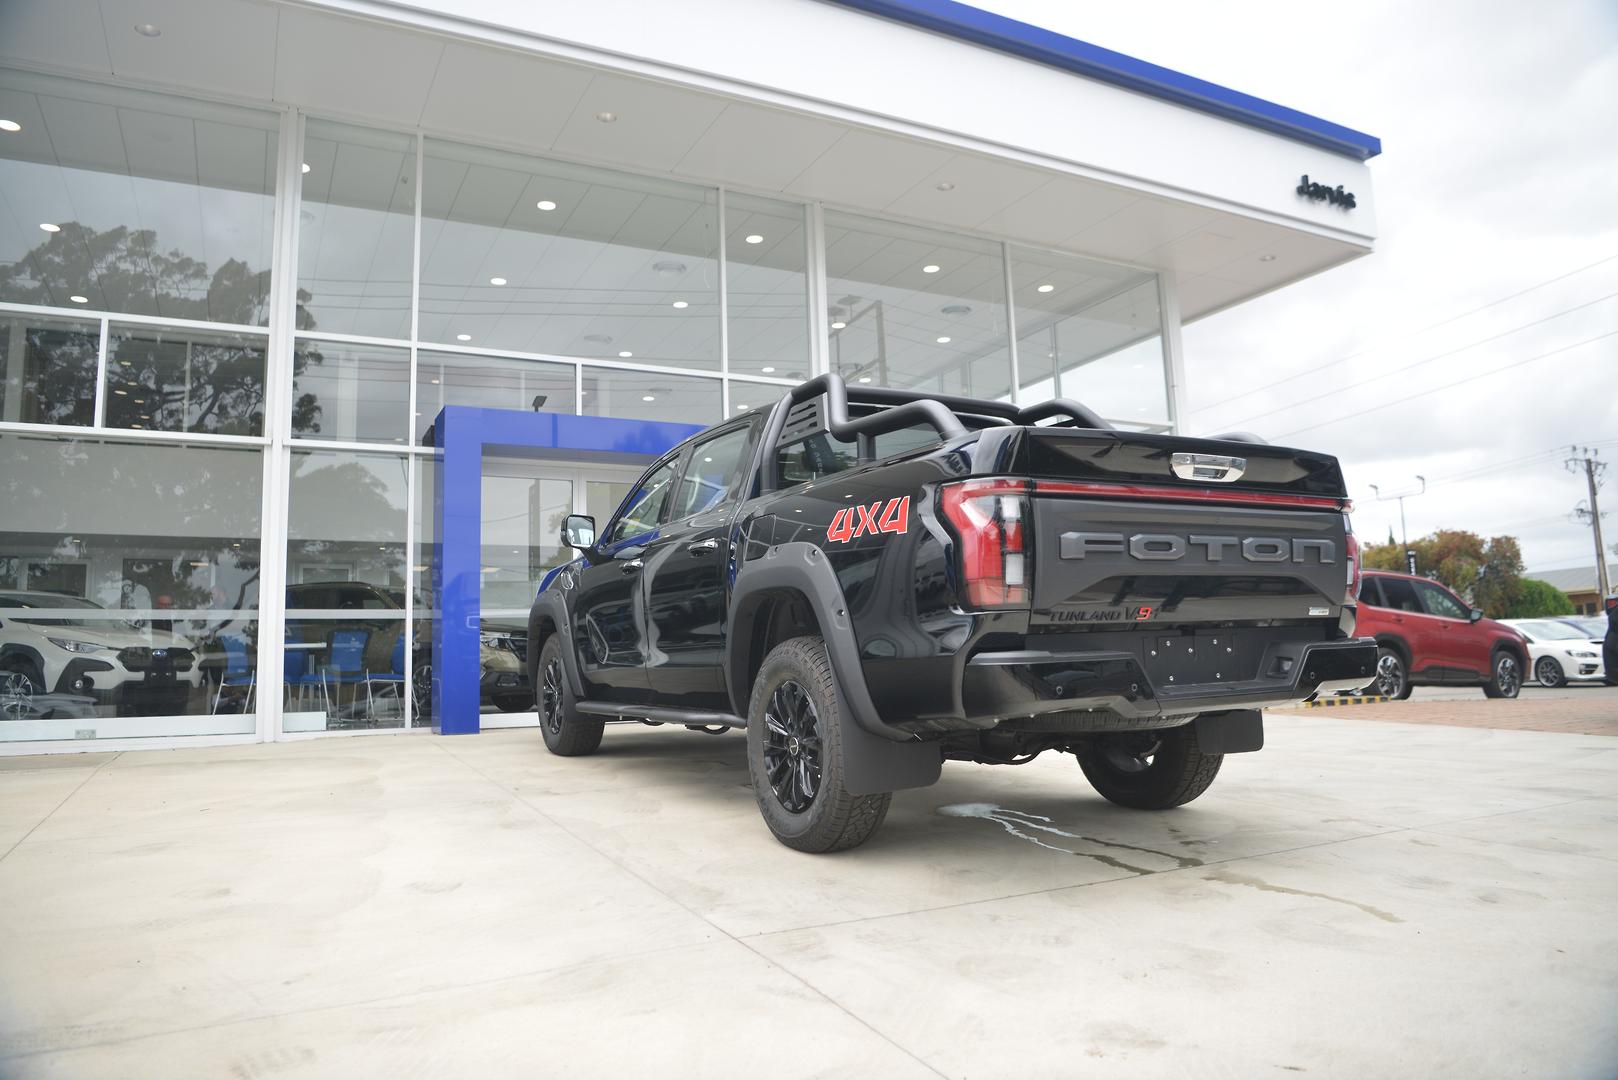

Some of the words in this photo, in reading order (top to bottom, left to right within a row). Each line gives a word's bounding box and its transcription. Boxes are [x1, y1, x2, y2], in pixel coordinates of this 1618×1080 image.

[827, 496, 910, 543] 4X4
[1060, 531, 1336, 564] FOTON
[1049, 610, 1120, 621] TUNLAND
